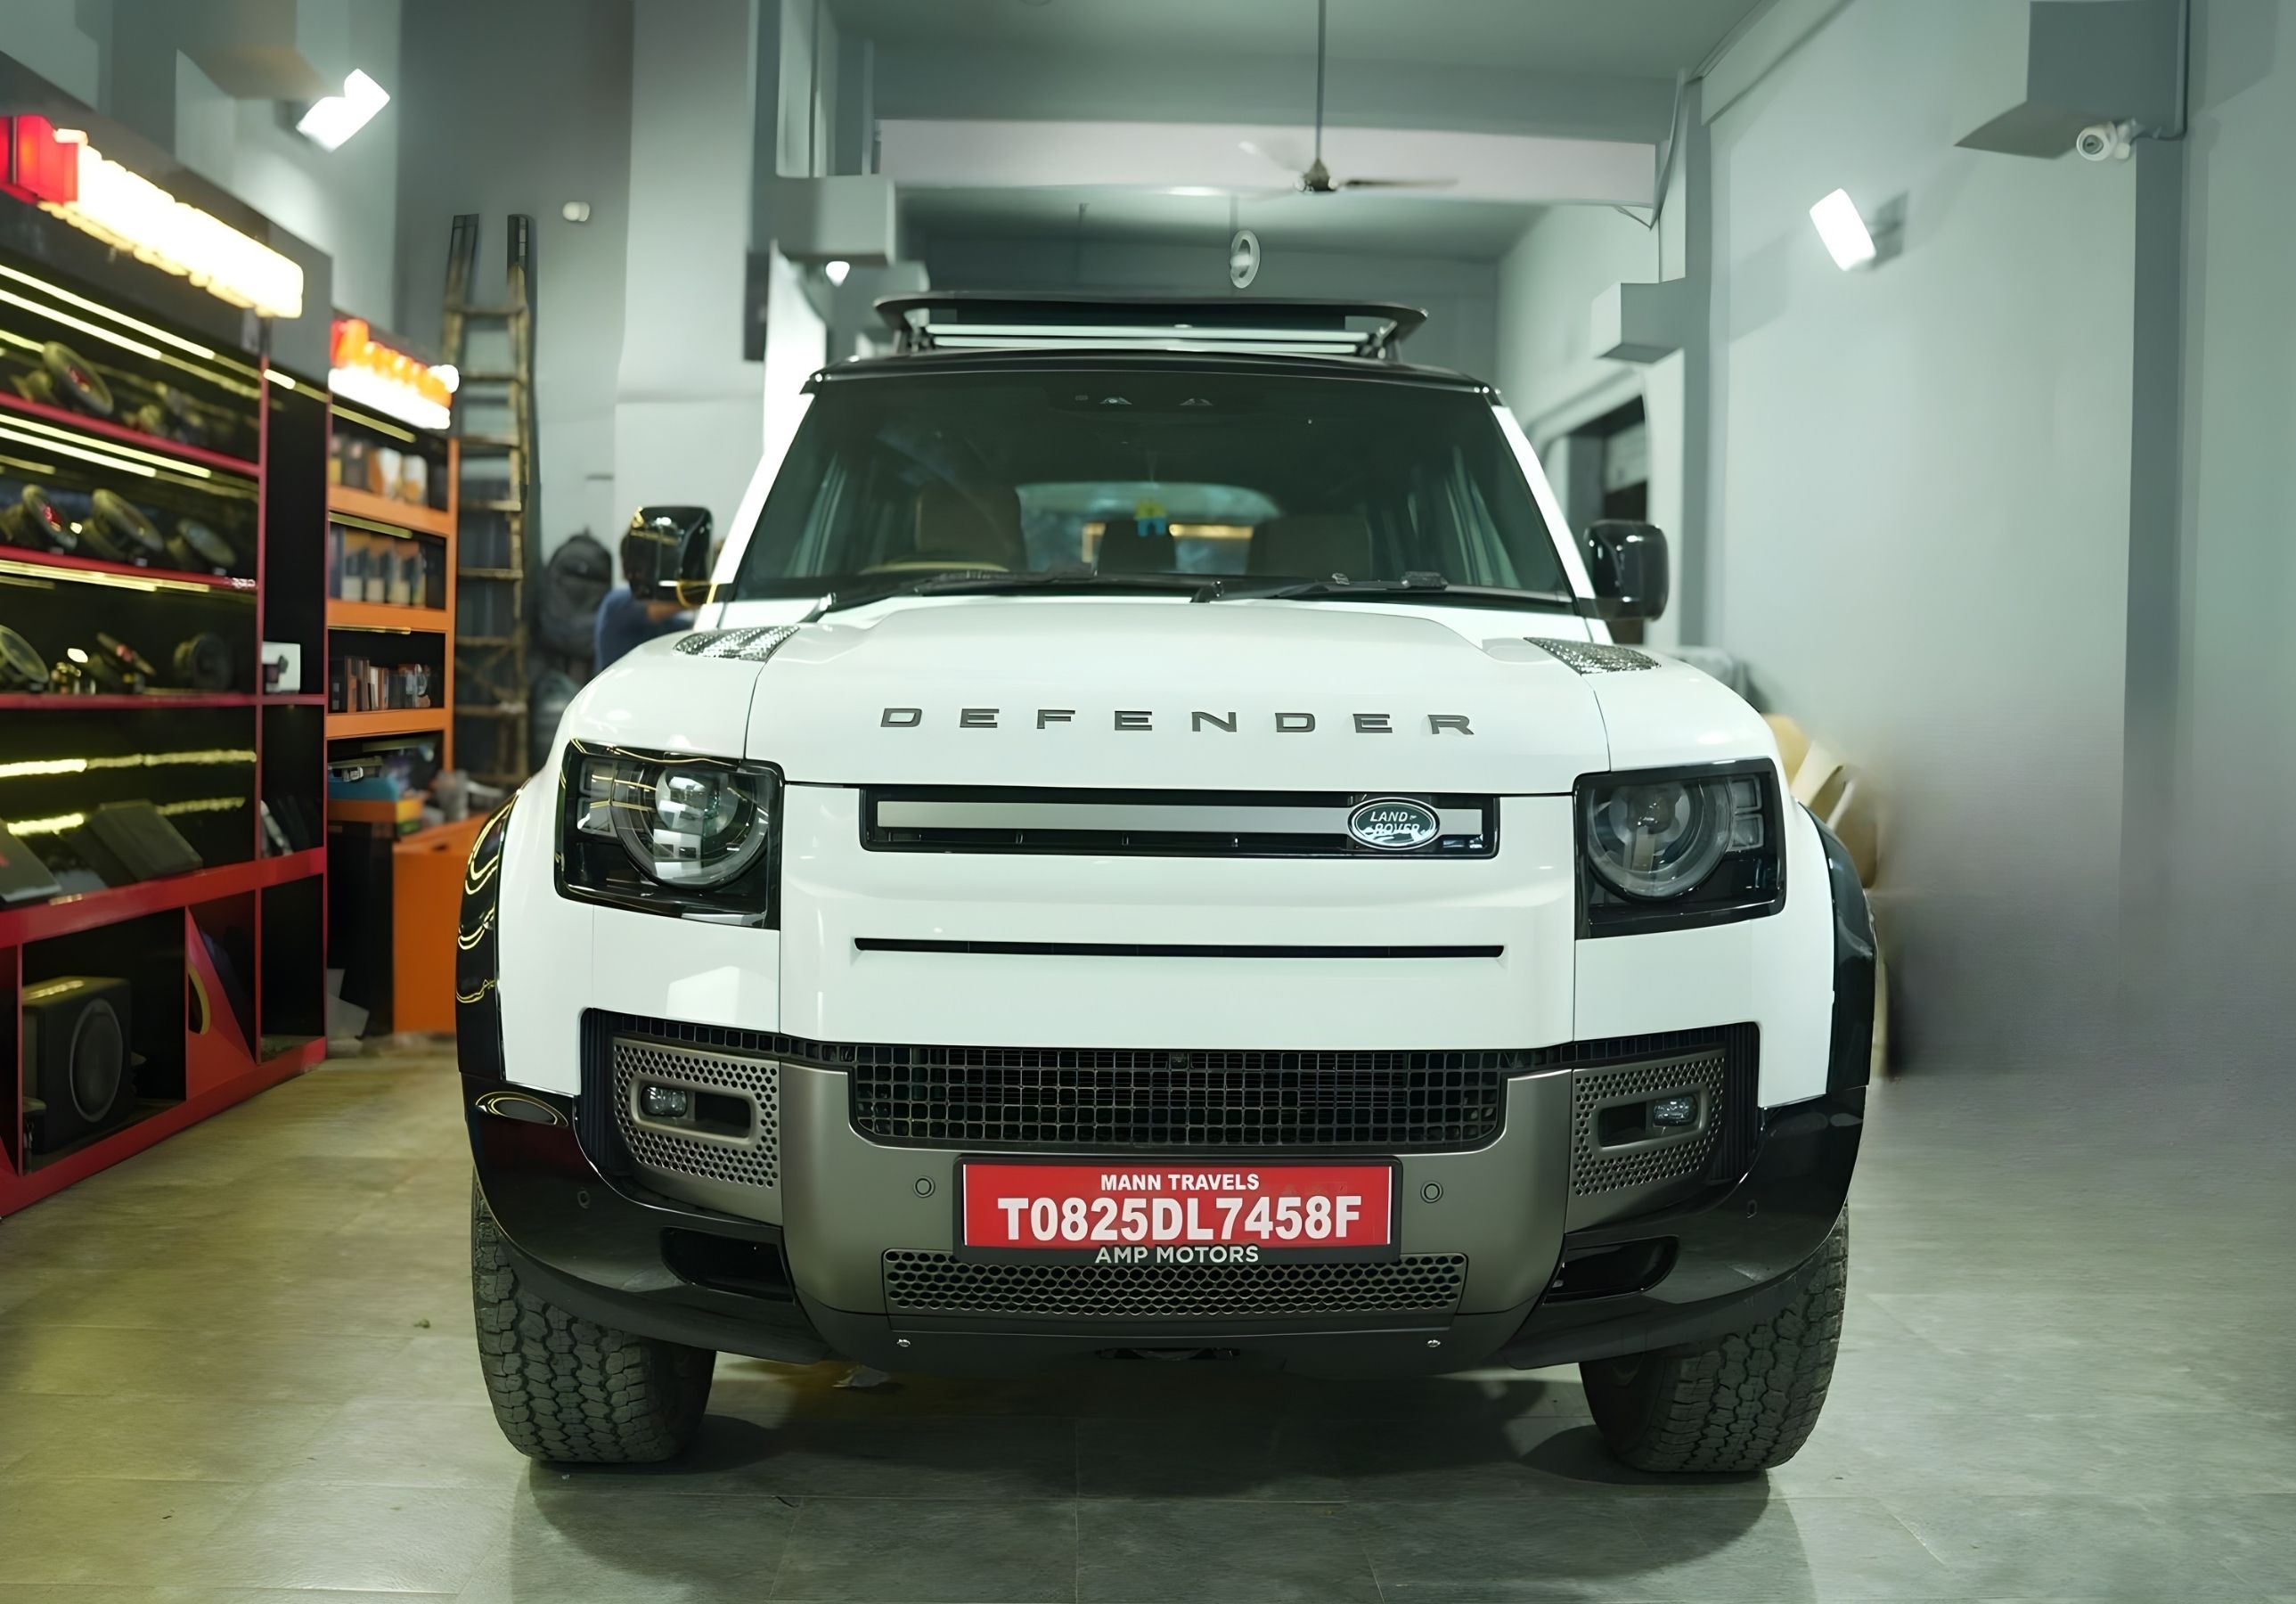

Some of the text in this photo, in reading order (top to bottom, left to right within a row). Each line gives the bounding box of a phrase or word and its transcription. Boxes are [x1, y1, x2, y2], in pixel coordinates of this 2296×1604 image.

[880, 708, 1475, 735] DEFENDER
[1370, 812, 1408, 822] LAND
[1374, 823, 1420, 836] ROVER
[1100, 1173, 1260, 1191] MANN TRAVELS
[997, 1195, 1362, 1241] T0825DL7458F
[1094, 1245, 1259, 1264] AMP MOTORS
